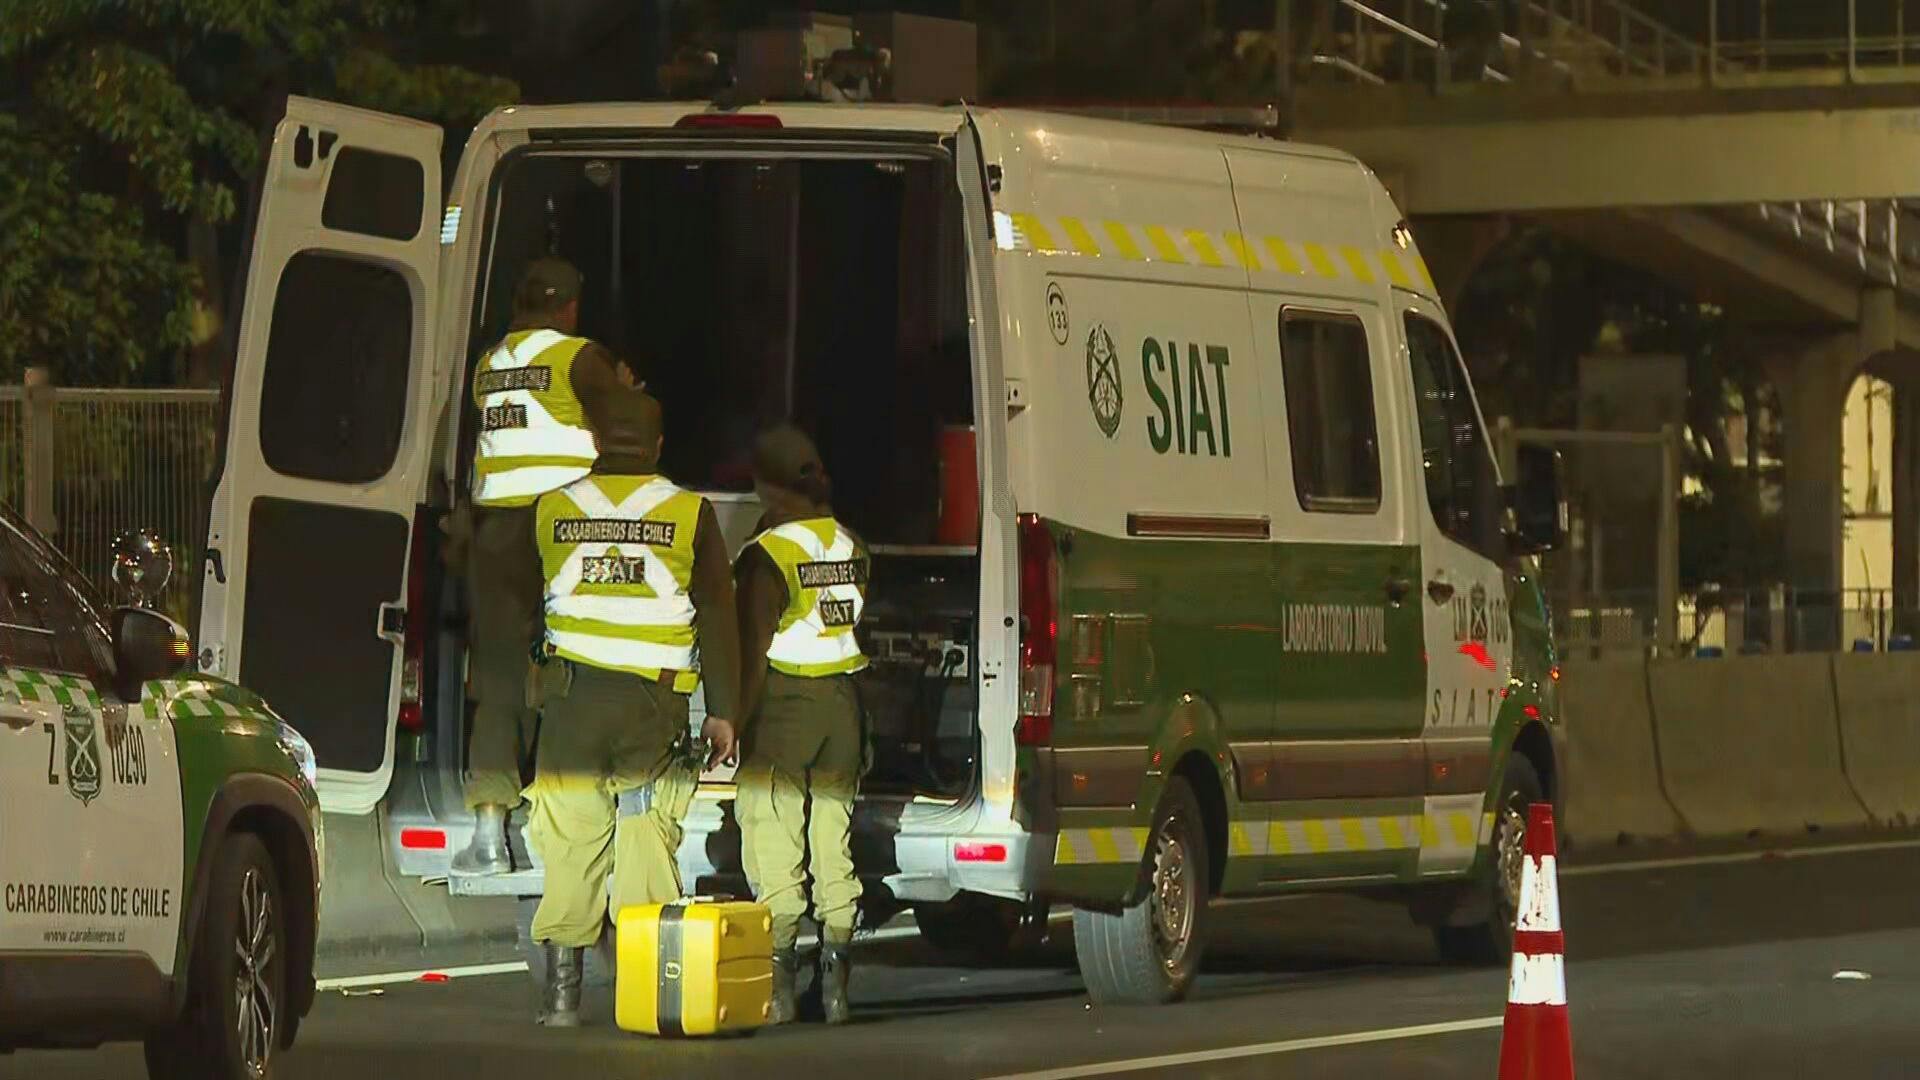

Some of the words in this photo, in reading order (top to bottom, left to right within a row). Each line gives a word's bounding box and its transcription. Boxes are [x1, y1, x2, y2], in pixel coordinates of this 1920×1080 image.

[1050, 311, 1067, 329] 133
[1142, 336, 1231, 458] SIAT
[488, 405, 523, 428] SIAT
[560, 522, 627, 541] CARABINEROS
[628, 523, 641, 540] DE
[643, 524, 673, 543] CHILE
[822, 602, 851, 623] SIAT
[1282, 603, 1353, 652] LABORATORIO
[44, 723, 59, 785] Z
[107, 724, 146, 785] 10290
[5, 883, 107, 916] CARABINEROS
[111, 886, 128, 917] DE
[132, 888, 170, 918] CHILE
